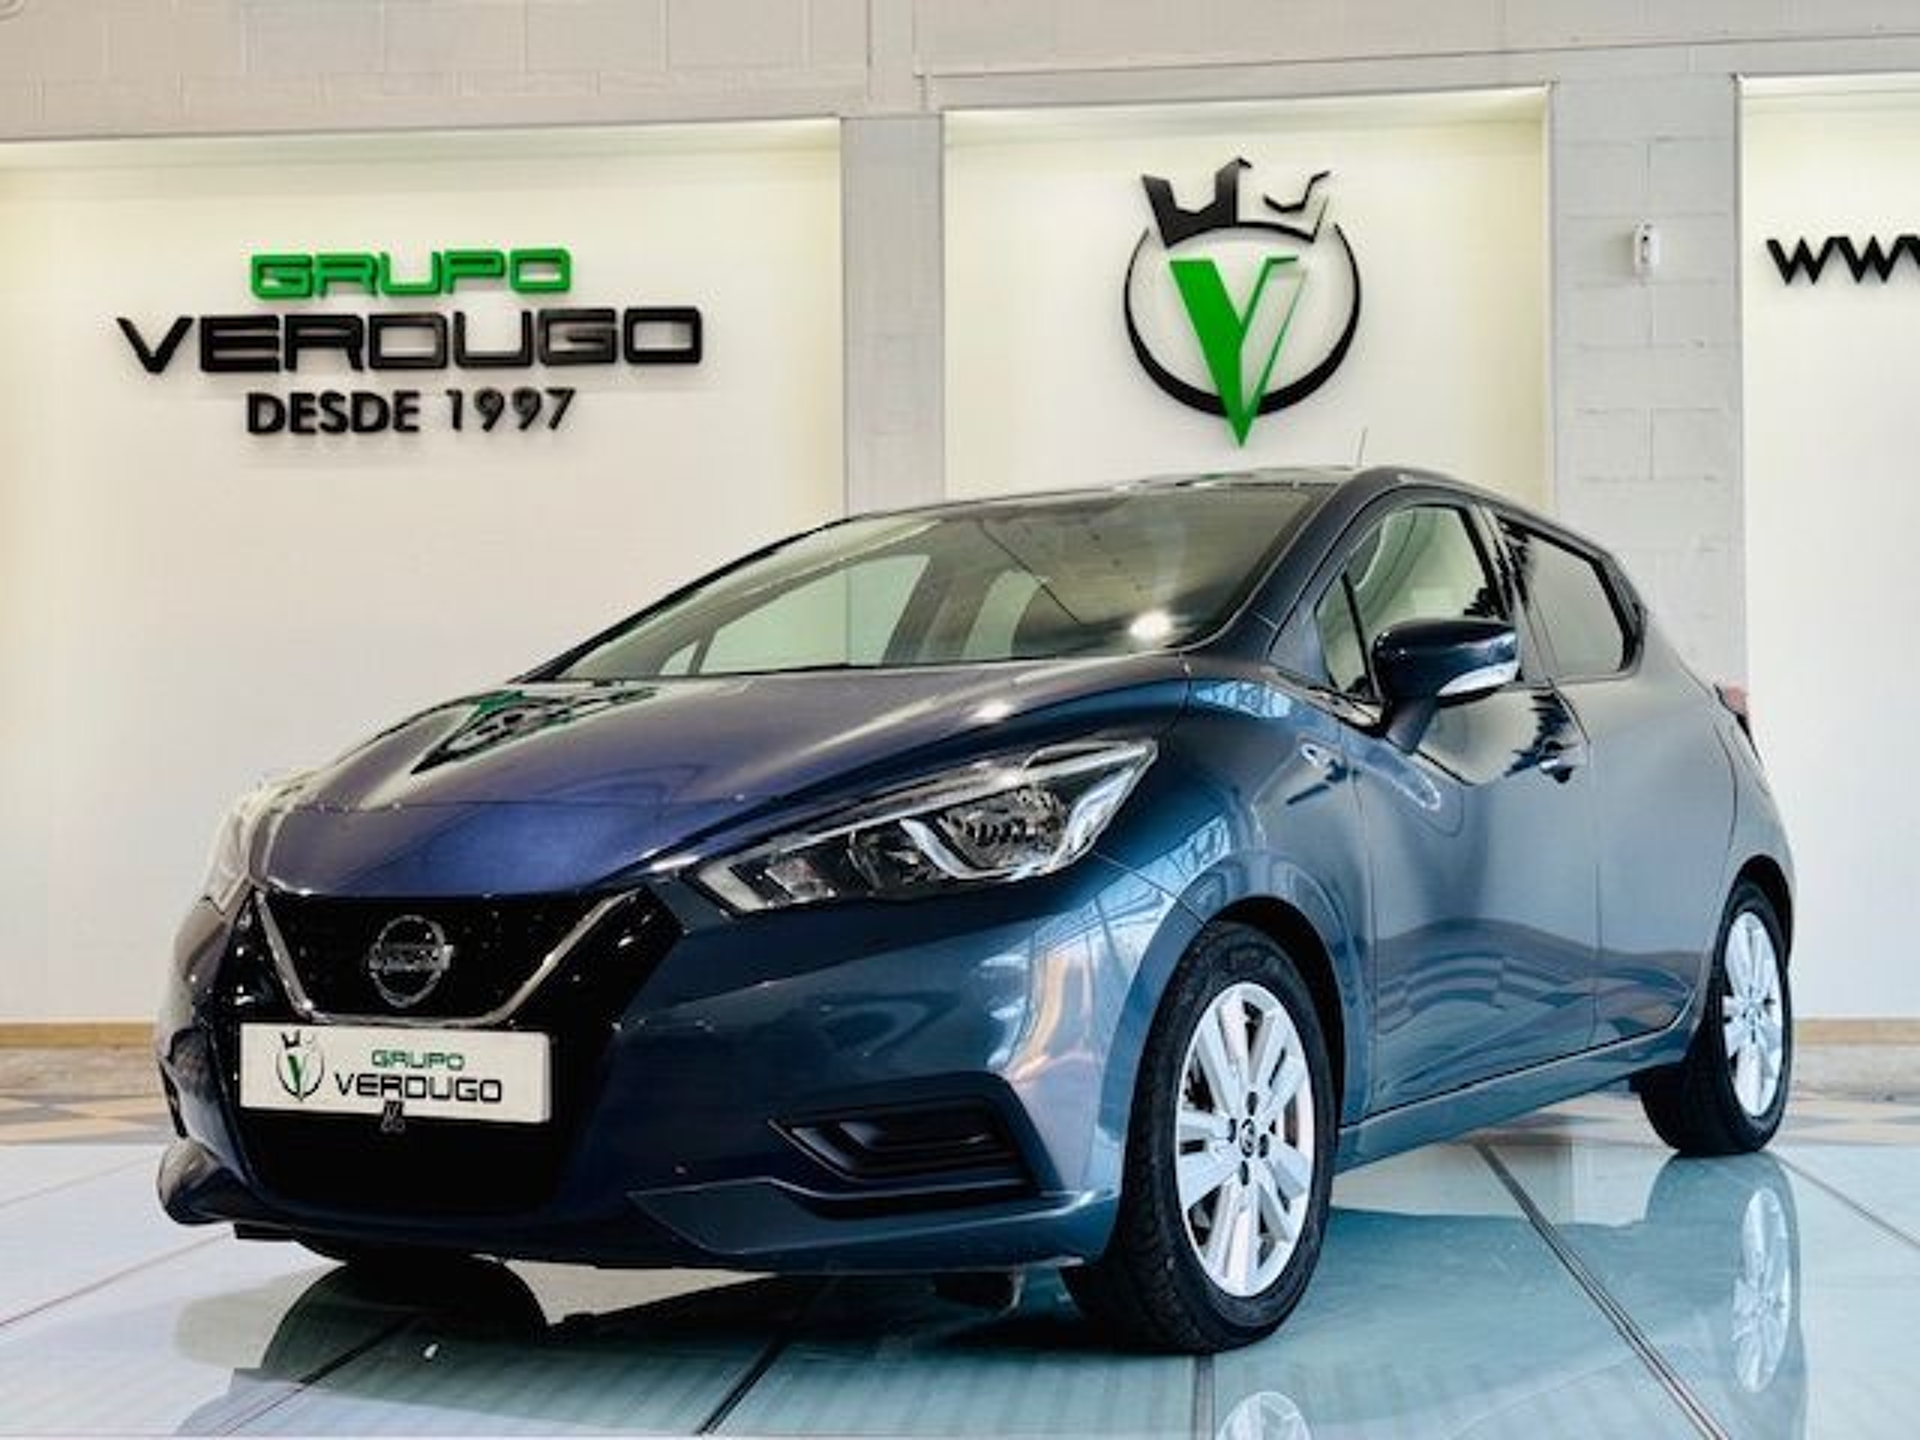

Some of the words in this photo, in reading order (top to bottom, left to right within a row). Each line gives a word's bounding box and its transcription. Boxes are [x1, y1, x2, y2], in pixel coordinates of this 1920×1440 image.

[249, 247, 572, 302] GRUPO
[116, 306, 703, 375] VERDUGO
[246, 389, 421, 437] DESDE
[445, 387, 577, 433] 1997
[371, 1049, 465, 1072] GRUPO
[334, 1072, 503, 1103] VERDUGO
